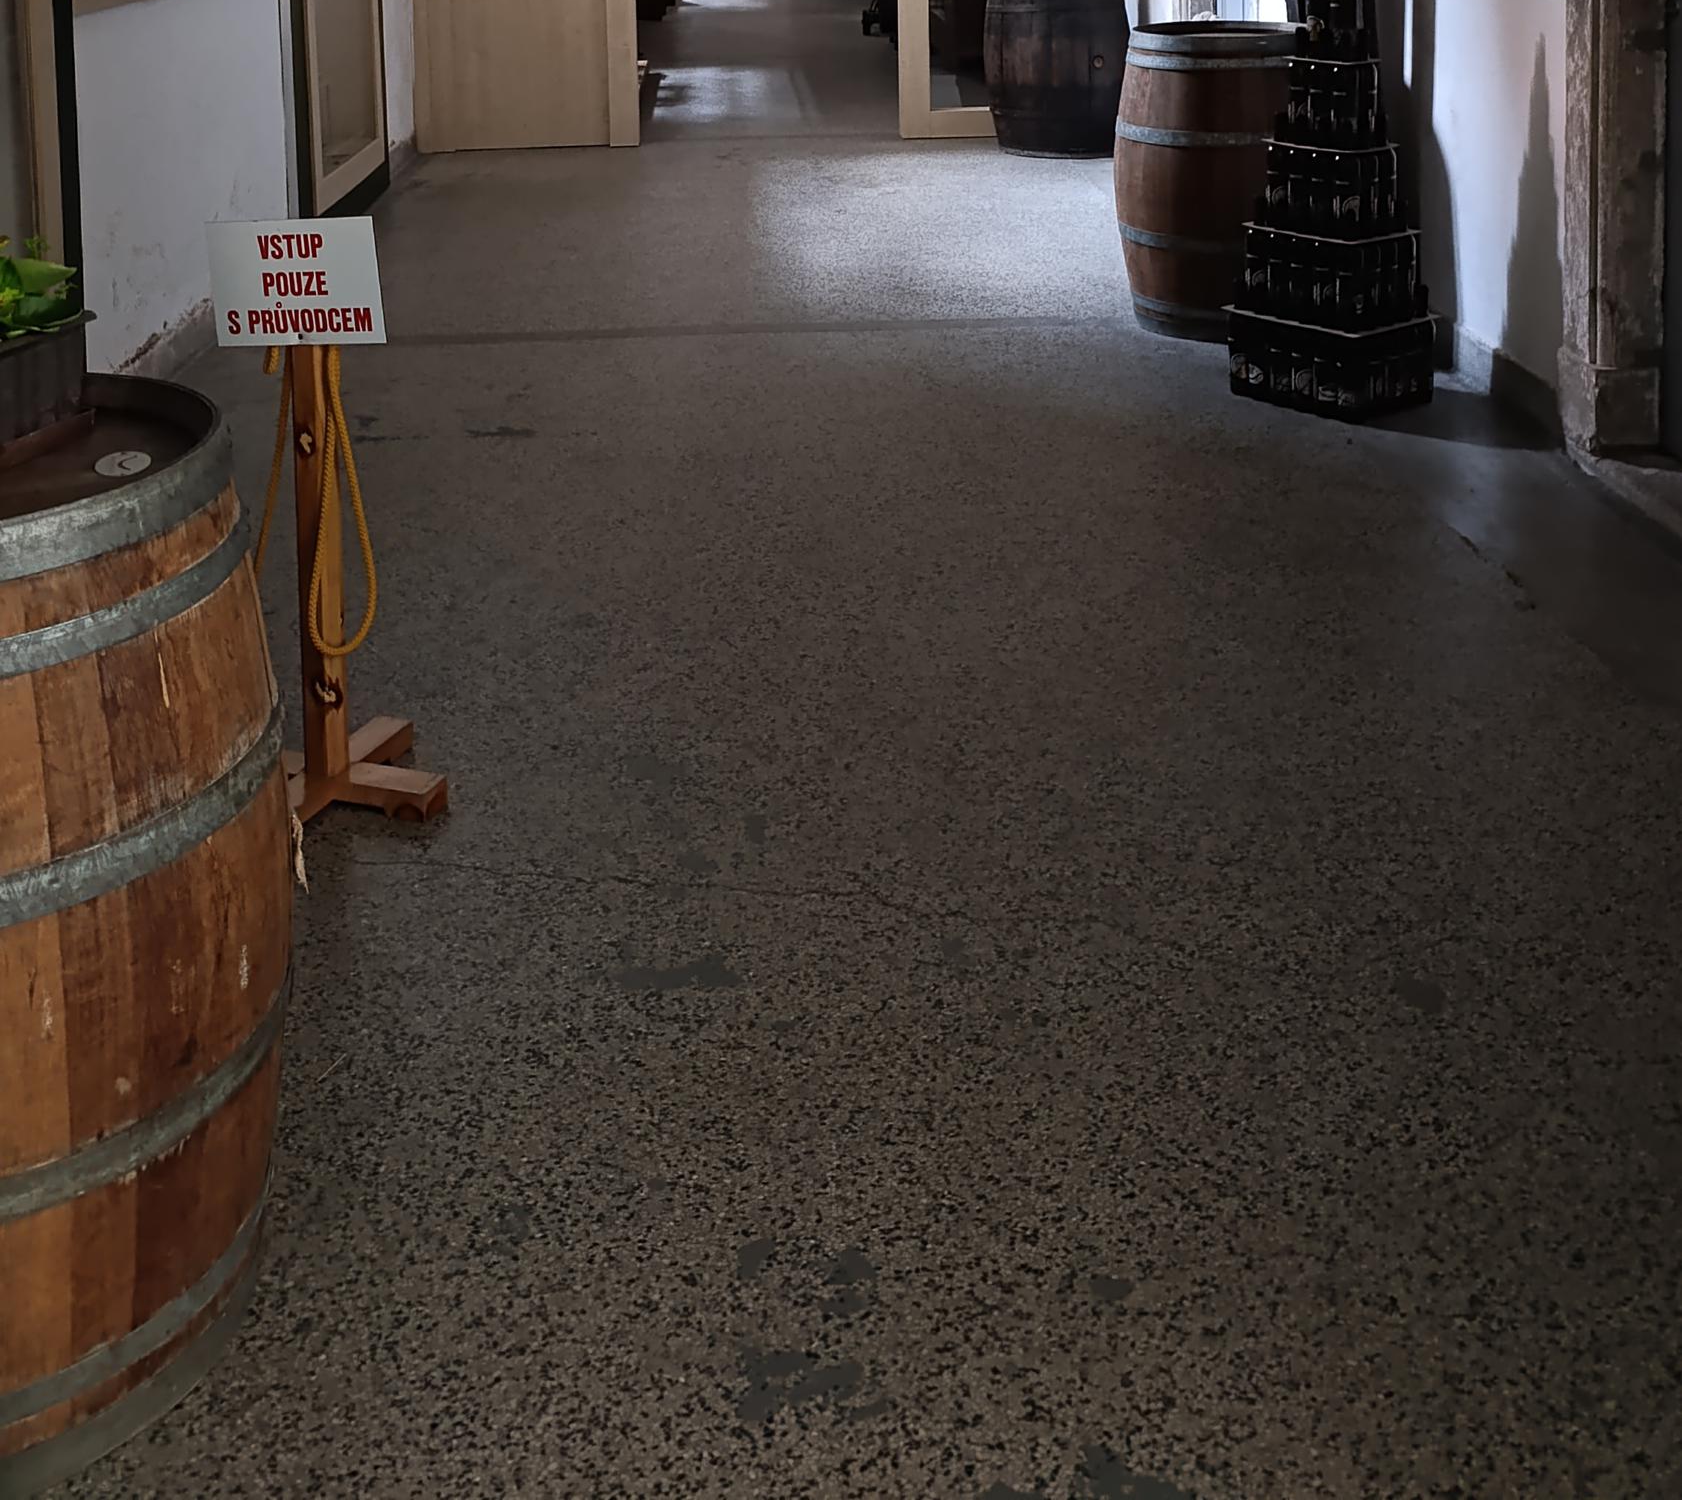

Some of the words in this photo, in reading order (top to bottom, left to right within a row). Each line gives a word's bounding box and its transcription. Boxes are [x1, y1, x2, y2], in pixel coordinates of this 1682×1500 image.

[256, 233, 323, 260] VSTUP
[262, 271, 329, 297] POUZE
[227, 310, 242, 335] S
[247, 301, 373, 334] PRŮVODCEM
